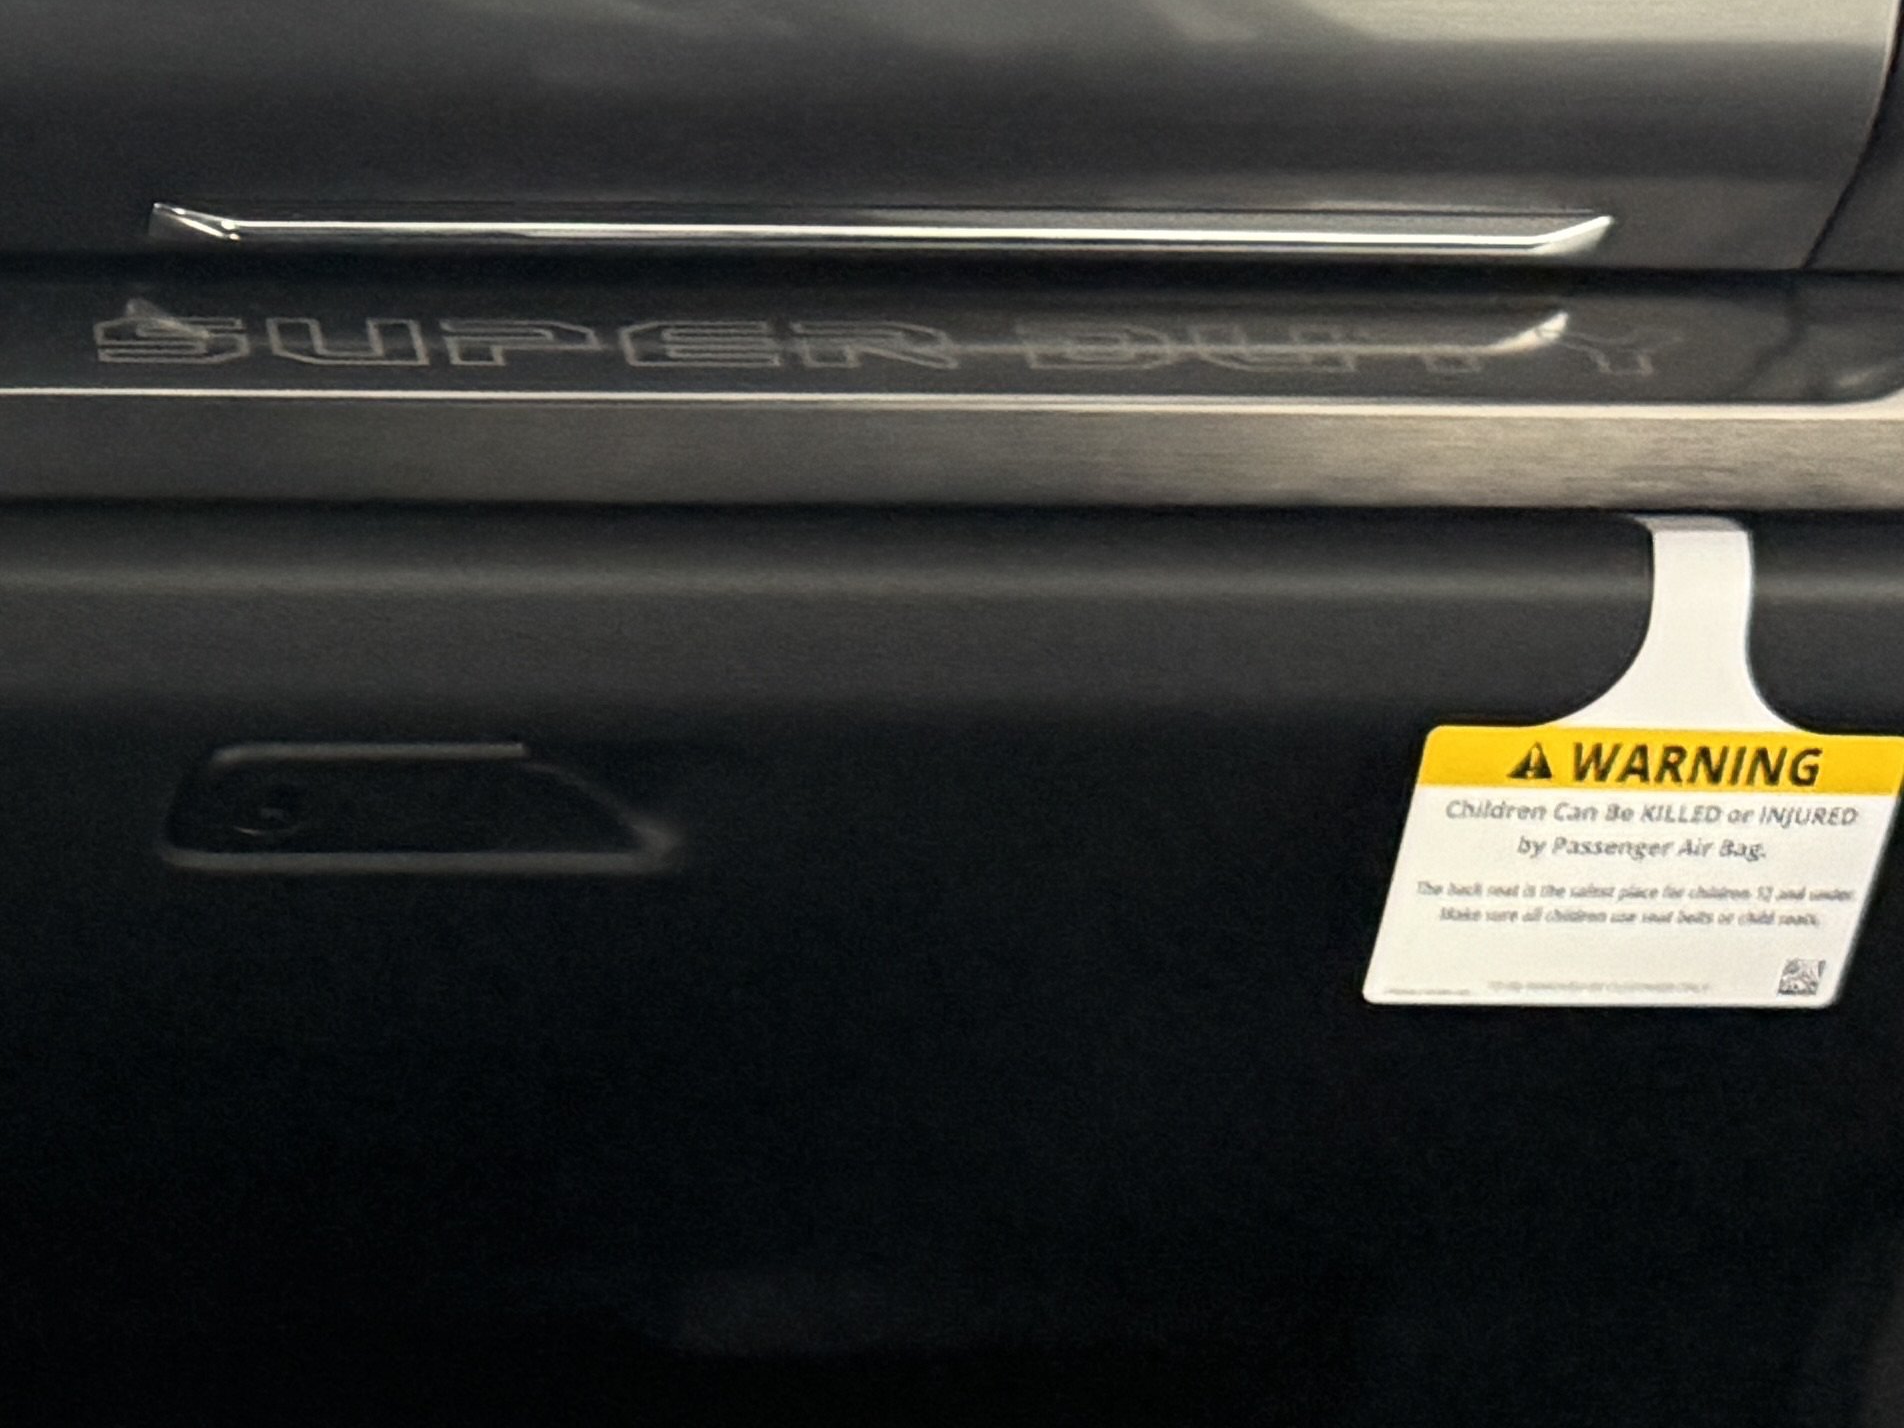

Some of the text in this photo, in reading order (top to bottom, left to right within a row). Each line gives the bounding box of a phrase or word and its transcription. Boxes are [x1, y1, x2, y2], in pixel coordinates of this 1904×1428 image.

[94, 315, 961, 370] SUPER
[1571, 742, 1825, 787] WARNING
[1446, 800, 1858, 829] Children Can Be KILLED or INJURED
[1517, 836, 1766, 862] by Passenger Air Bag.
